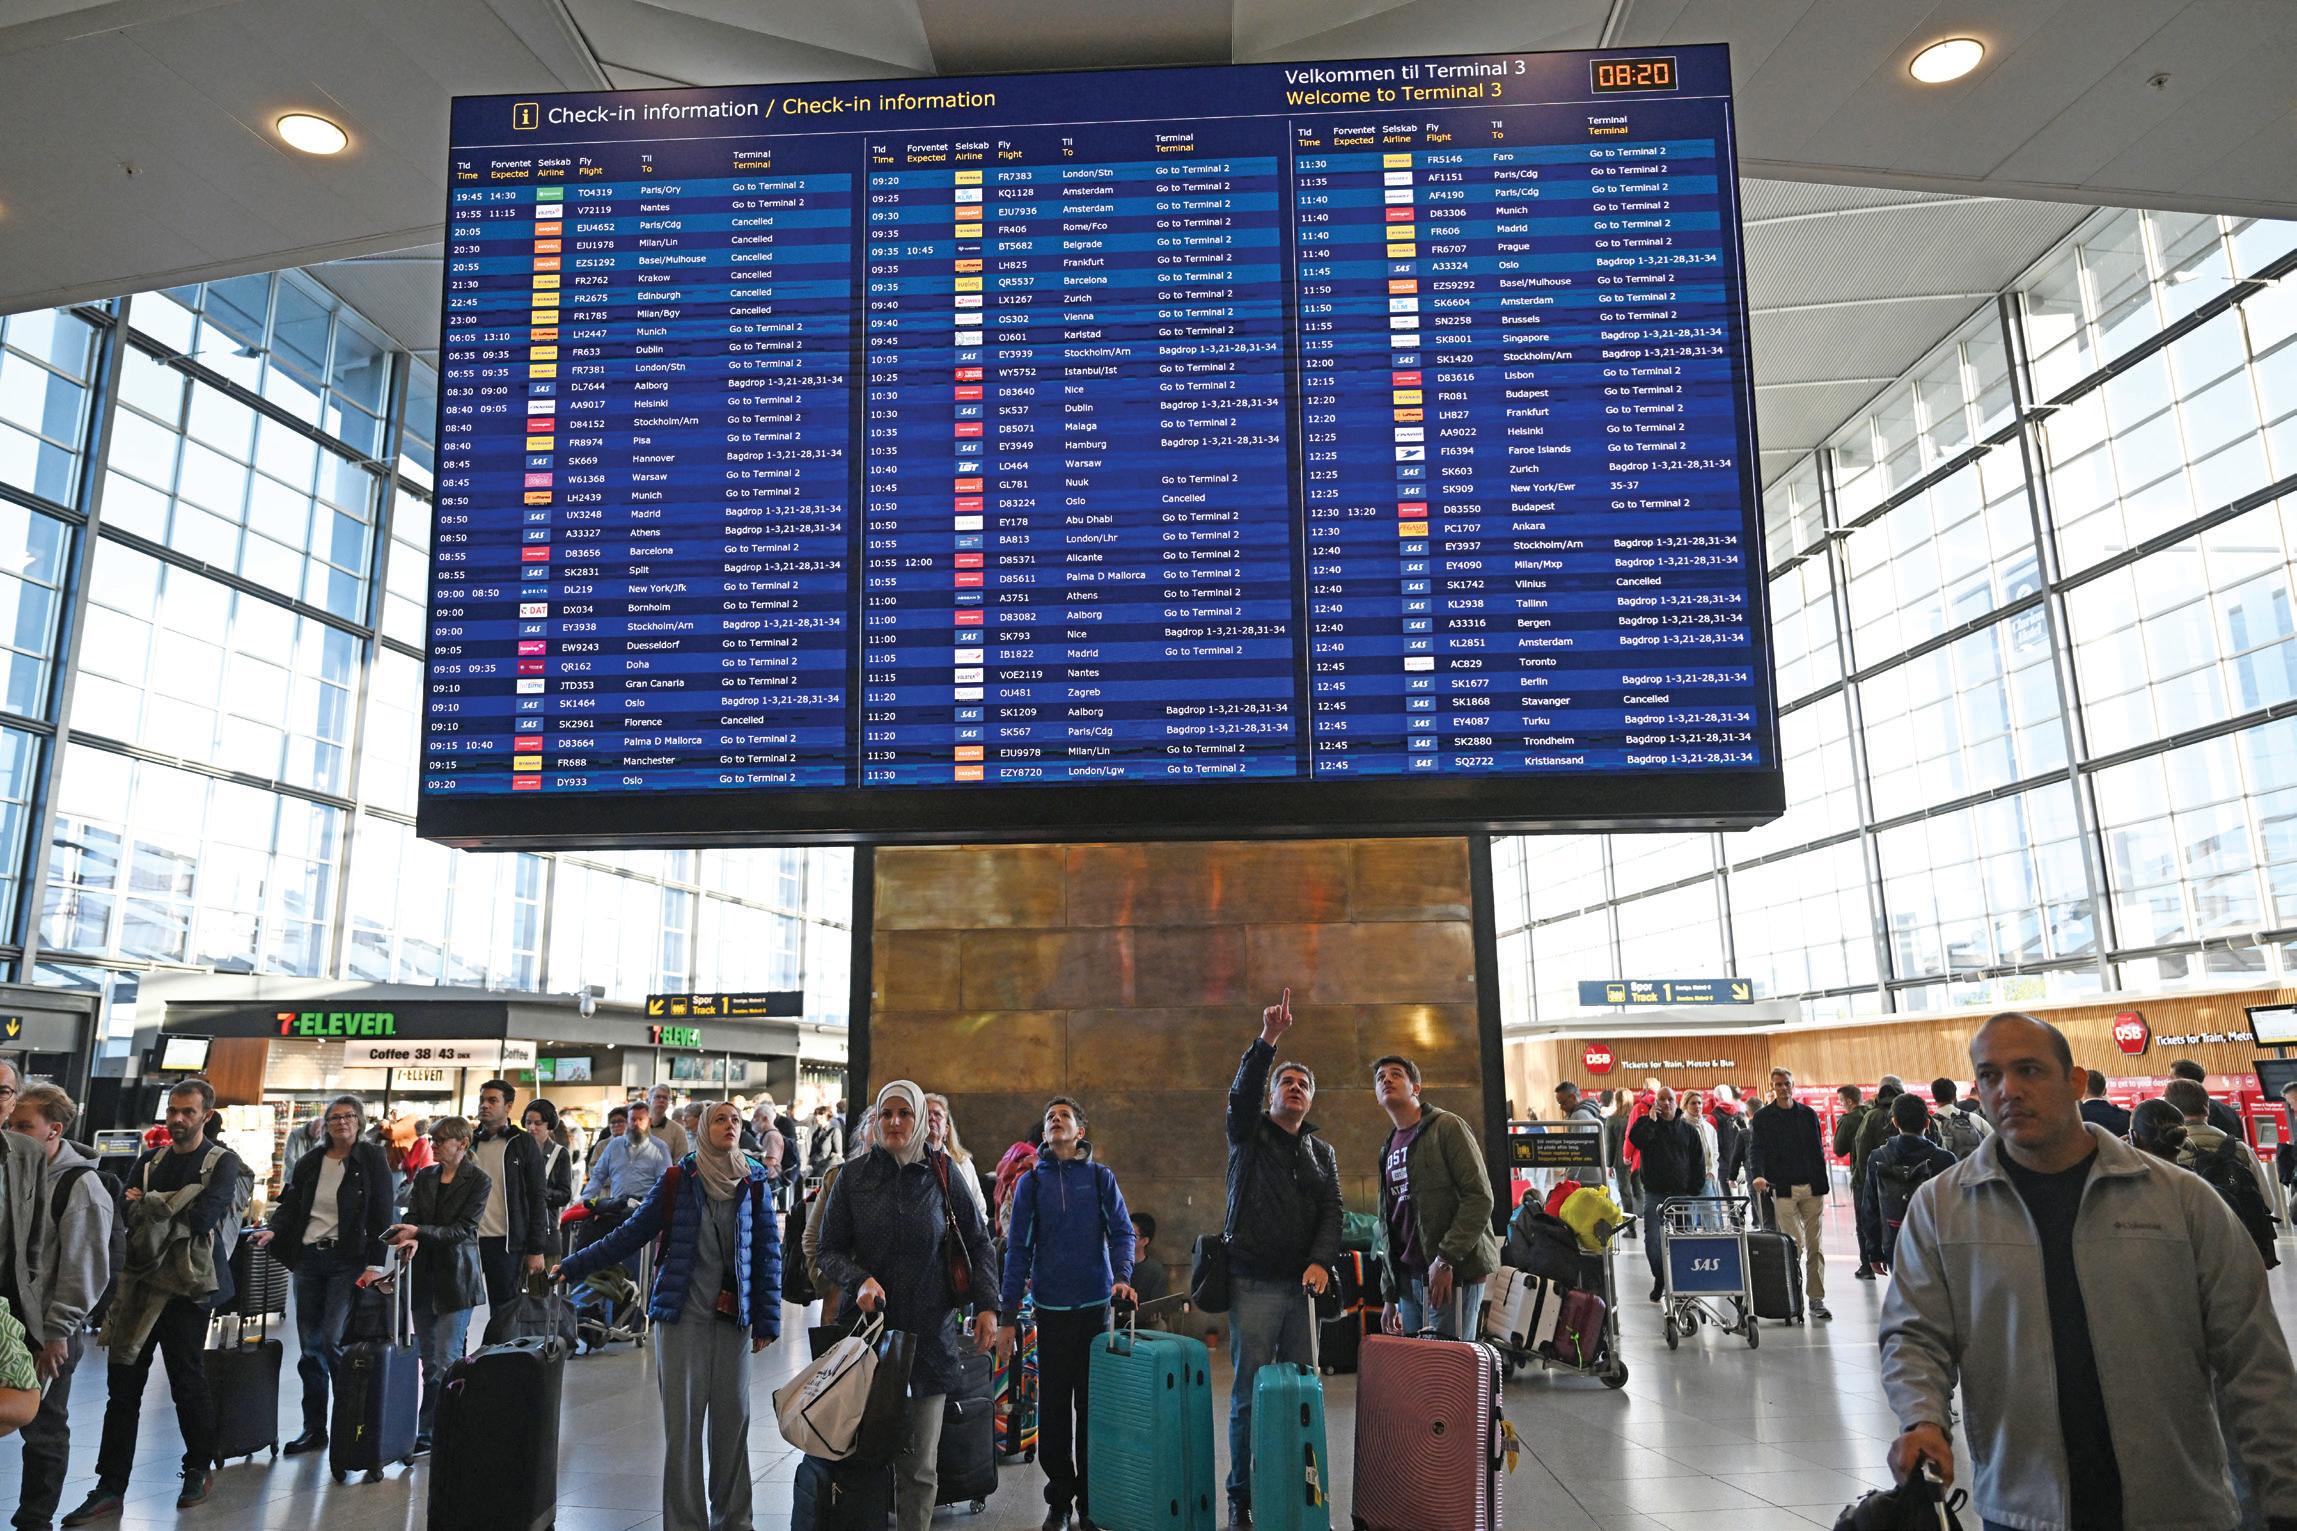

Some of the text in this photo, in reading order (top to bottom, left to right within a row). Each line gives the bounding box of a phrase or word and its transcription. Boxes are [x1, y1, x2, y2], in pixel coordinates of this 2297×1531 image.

[1284, 59, 1526, 85] Velkommen til Terminal 3
[1598, 63, 1669, 87] 08:20
[1286, 81, 1503, 106] Welcome to Terminal 3
[548, 91, 996, 124] Check-in information / Check-in information
[1297, 128, 1312, 137] Tid
[1333, 126, 1376, 135] Forventet
[1382, 124, 1418, 133] Selskab
[1587, 115, 1628, 125] Terminal
[1297, 139, 1321, 147] Time
[1333, 136, 1374, 147] Expected
[1382, 135, 1412, 144] Airline
[1426, 133, 1452, 143] Flight
[1587, 126, 1629, 135] Terminal
[491, 159, 532, 169] Forventet
[537, 158, 572, 167] Selskab
[732, 149, 771, 159] Terminal
[1299, 153, 1514, 169] 11:30 FR5146 Faro
[457, 172, 479, 180] Time
[490, 169, 529, 180] Expected
[537, 169, 565, 177] Airline
[579, 167, 603, 177] Flight
[733, 160, 771, 169] Terminal
[872, 176, 900, 186] 09:20
[998, 171, 1032, 181] FR7383
[1062, 168, 1114, 178] London/Stn
[1182, 164, 1222, 174] Terminal
[456, 192, 483, 202] 19:45
[490, 191, 517, 201] 14:30
[577, 188, 613, 197] TO4319
[640, 185, 682, 195] Paris/Ory
[758, 181, 797, 190] Terminal
[452, 252, 773, 272] 20:55 EZS1292 Basel/Mulhouse Cancelled
[871, 283, 899, 292] 09:35
[998, 277, 1035, 288] QR5537
[1063, 276, 1108, 285] Barcelona
[446, 375, 843, 397] 08:30 09:00 SAS DL7644 Aalborg Bagdrop 1-3,21-28,31-34
[871, 435, 1280, 456] 10:35 SAS EY3949 Hamburg Bagdrop 1-3,21-28,31-34
[1311, 480, 1639, 499] 12:25 SAS SK909 New York/Ewr 35-37
[1311, 508, 1340, 518] 12:30
[1348, 507, 1376, 517] 13:20
[1443, 504, 1481, 514] D83550
[1511, 502, 1556, 513] Budapest
[1639, 498, 1682, 508] Terminal
[436, 603, 671, 617] 09:00 DAT DX034 Bornholm
[868, 668, 1100, 683] 11:15 VOE2119 Nantes
[431, 715, 764, 731] 09:10 SAS SK2961 Florence Cancelled
[1319, 752, 1753, 770] 12:45 SAS SQ2722 Kristiansand Bagdrop 1-3,21-28,31-34
[428, 775, 643, 789] 09:20 DY933 Oslo
[868, 766, 1125, 780] 11:30 EZY8720 London/Lgw
[1630, 982, 1653, 993] Spor
[1663, 983, 1673, 1002] 1
[1631, 992, 1659, 1002] Track
[692, 995, 713, 1005] Spor
[721, 996, 729, 1015] 1
[692, 1006, 717, 1015] Track
[2115, 1026, 2143, 1041] DSB
[2155, 1034, 2186, 1046] Tickets
[2186, 1034, 2201, 1045] for
[2201, 1032, 2228, 1044] Train,
[369, 1048, 410, 1060] Coffee
[414, 1048, 431, 1060] 38
[438, 1048, 455, 1060] 43
[503, 1047, 529, 1060] Coffee
[1585, 1053, 1612, 1065] DSB
[1621, 1059, 1736, 1070] Tickets for Train, Metro & Bus
[1690, 1258, 1721, 1272] SAS
